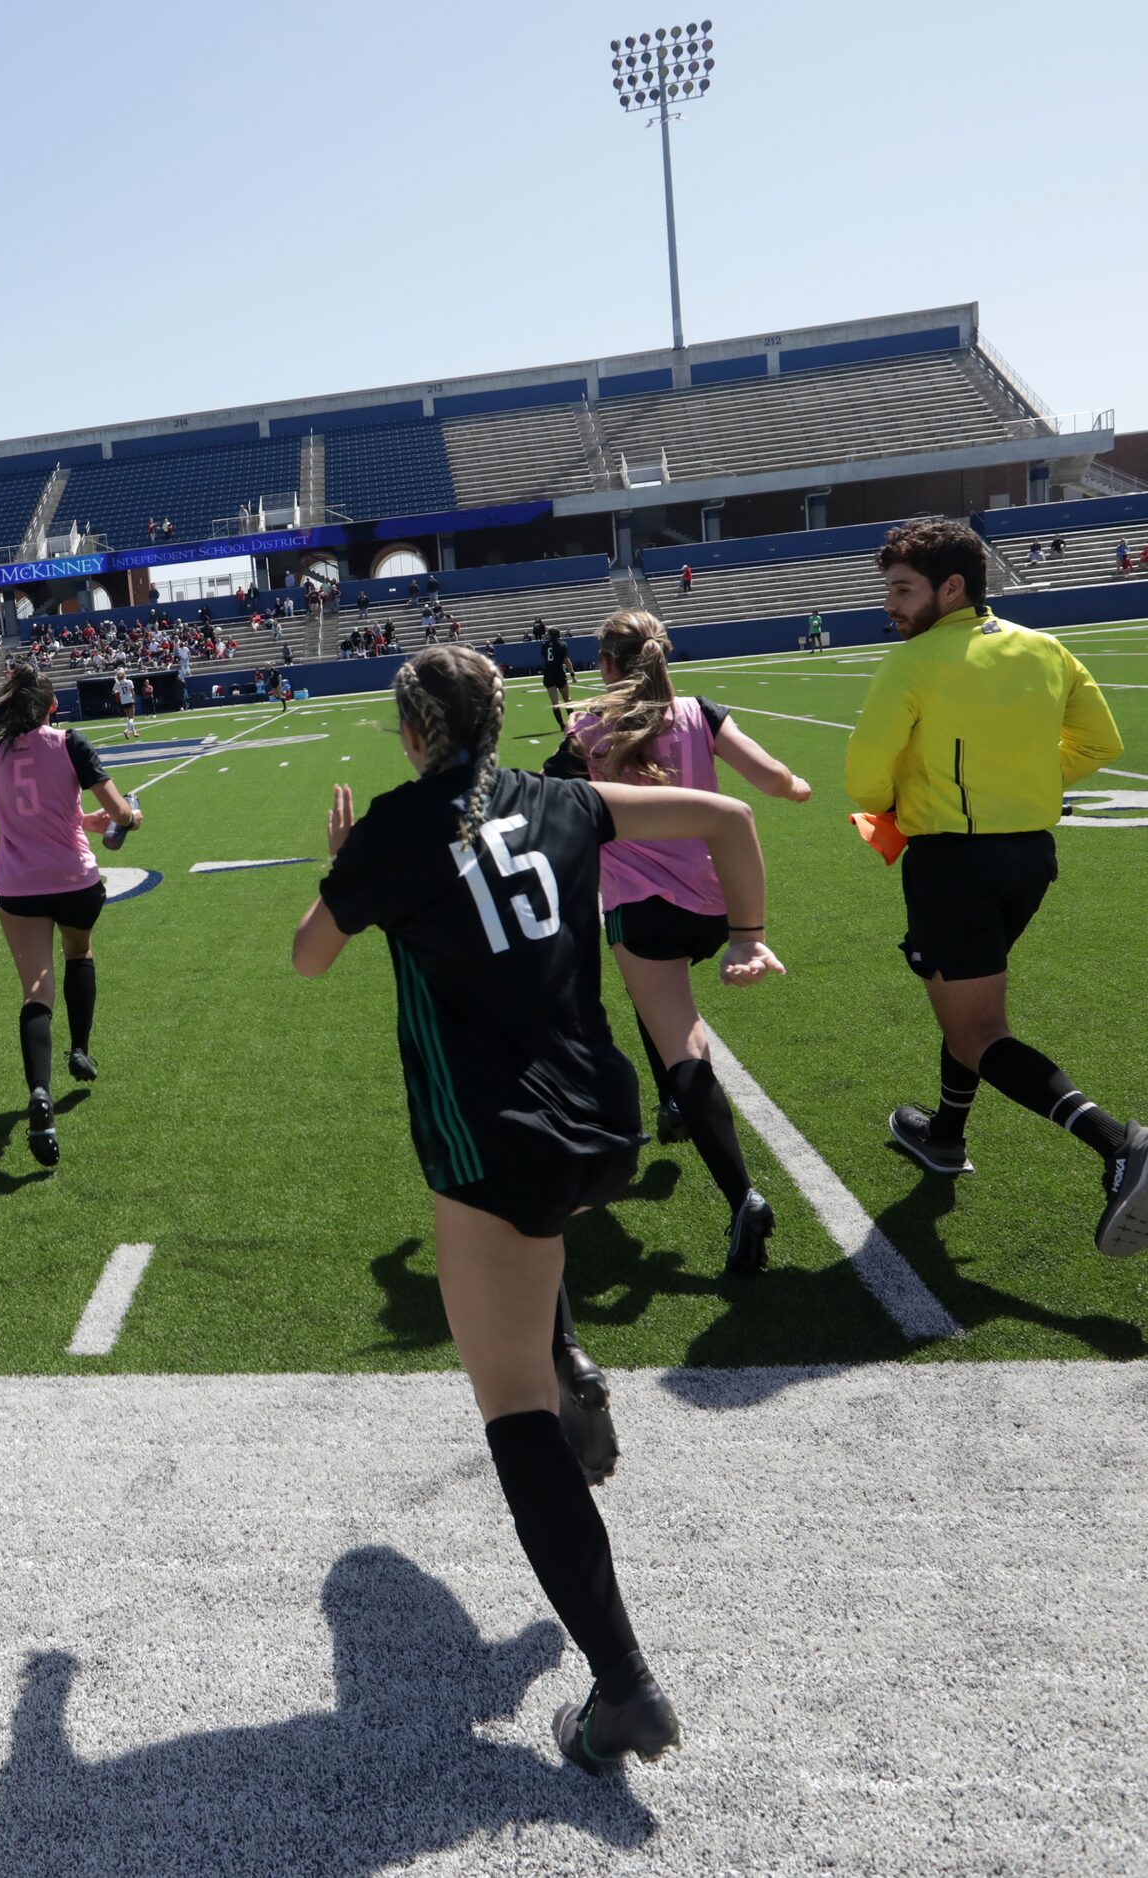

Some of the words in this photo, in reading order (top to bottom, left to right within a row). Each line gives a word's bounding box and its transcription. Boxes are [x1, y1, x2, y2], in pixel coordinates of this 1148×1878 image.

[763, 335, 782, 347] 212
[427, 383, 444, 394] 213
[13, 757, 40, 816] 5
[448, 813, 561, 954] 15
[1111, 1158, 1126, 1193] HOKA
